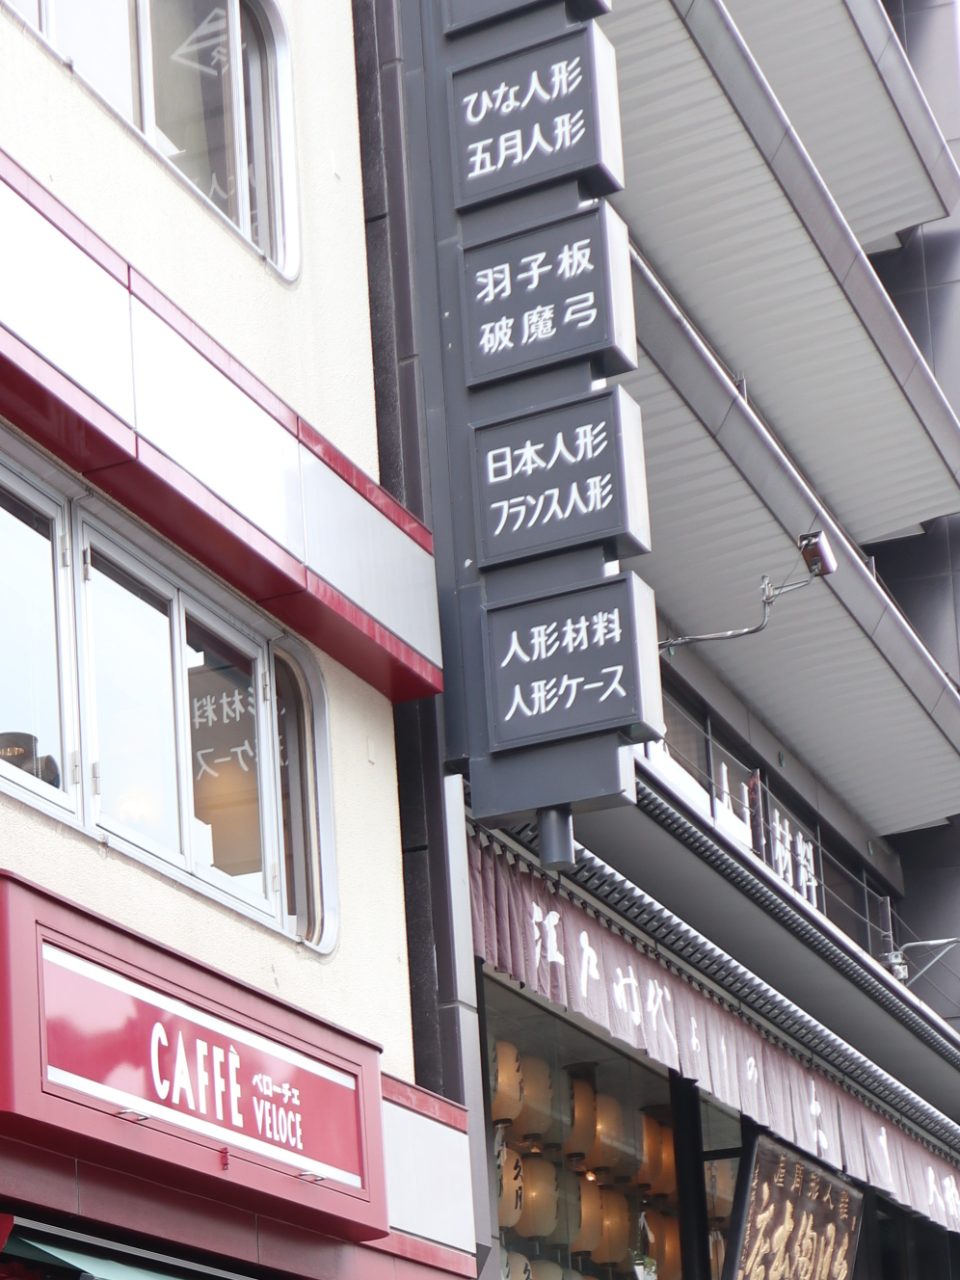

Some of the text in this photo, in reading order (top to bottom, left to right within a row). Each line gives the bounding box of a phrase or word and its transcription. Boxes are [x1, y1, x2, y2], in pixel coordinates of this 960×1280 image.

[462, 57, 582, 124] ひな人形
[467, 109, 586, 178] 五月人形
[475, 237, 595, 300] 羽子板
[479, 291, 598, 354] 破魔弓
[487, 421, 608, 484] 日本人形
[491, 473, 613, 537] フランス人形
[500, 607, 623, 668] 人形材料
[503, 664, 628, 722] 人形ケース
[252, 1096, 303, 1150] VELOCE
